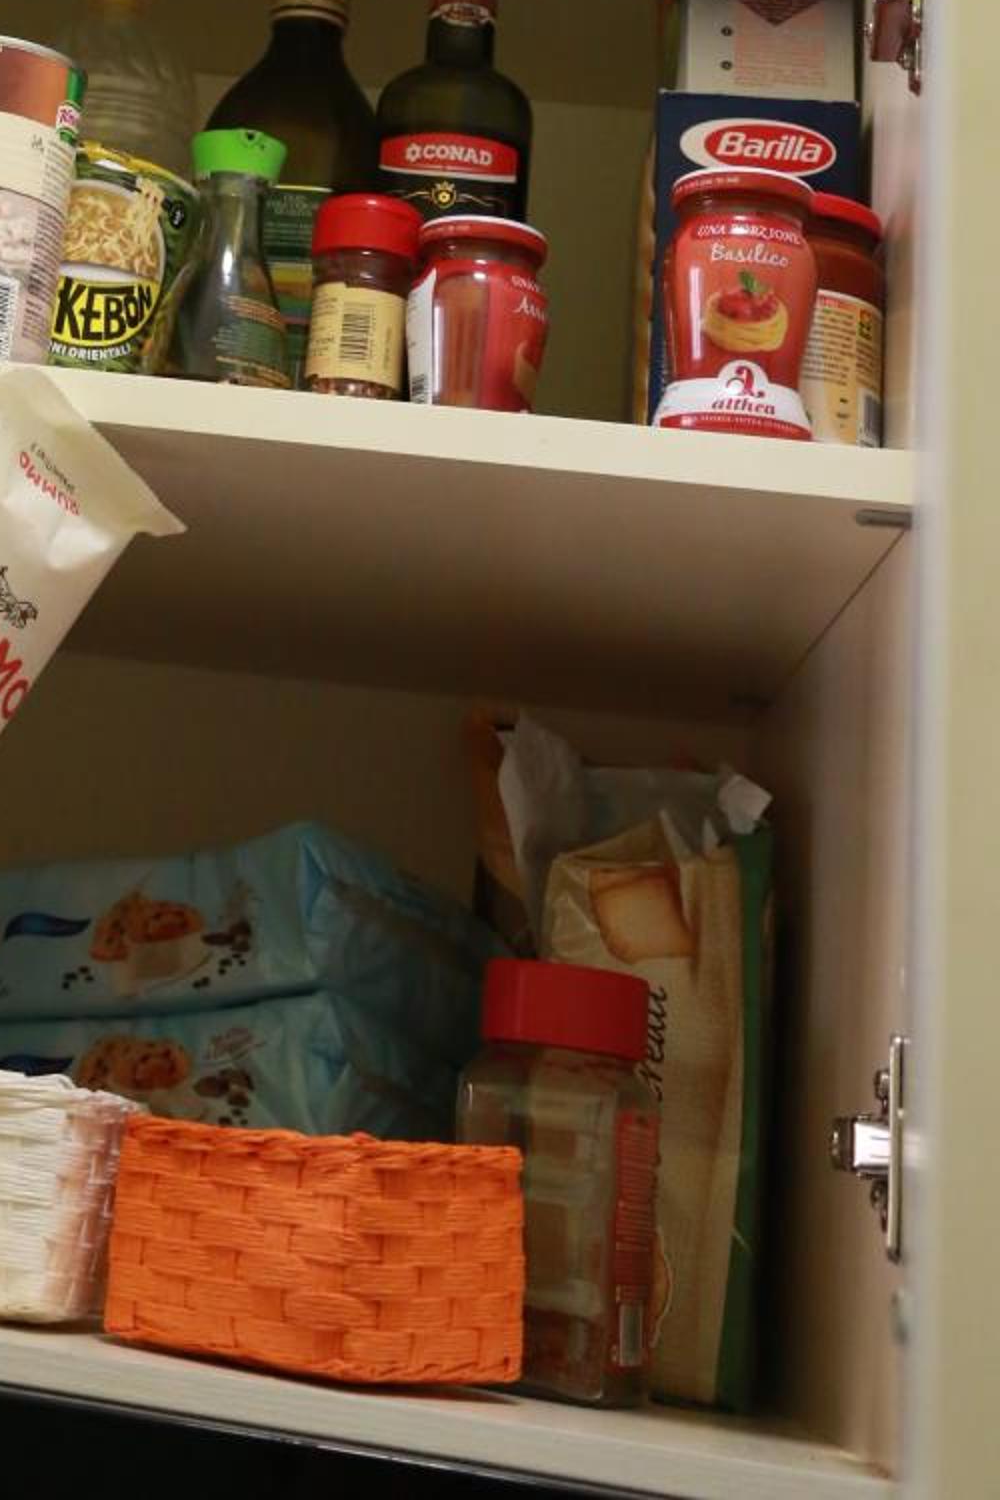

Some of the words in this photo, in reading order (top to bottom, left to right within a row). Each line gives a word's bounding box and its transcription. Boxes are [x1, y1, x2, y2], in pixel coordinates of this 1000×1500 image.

[422, 143, 494, 166] CONAD
[715, 132, 823, 164] Barilla
[710, 241, 790, 269] Basilico
[711, 397, 776, 416] althea
